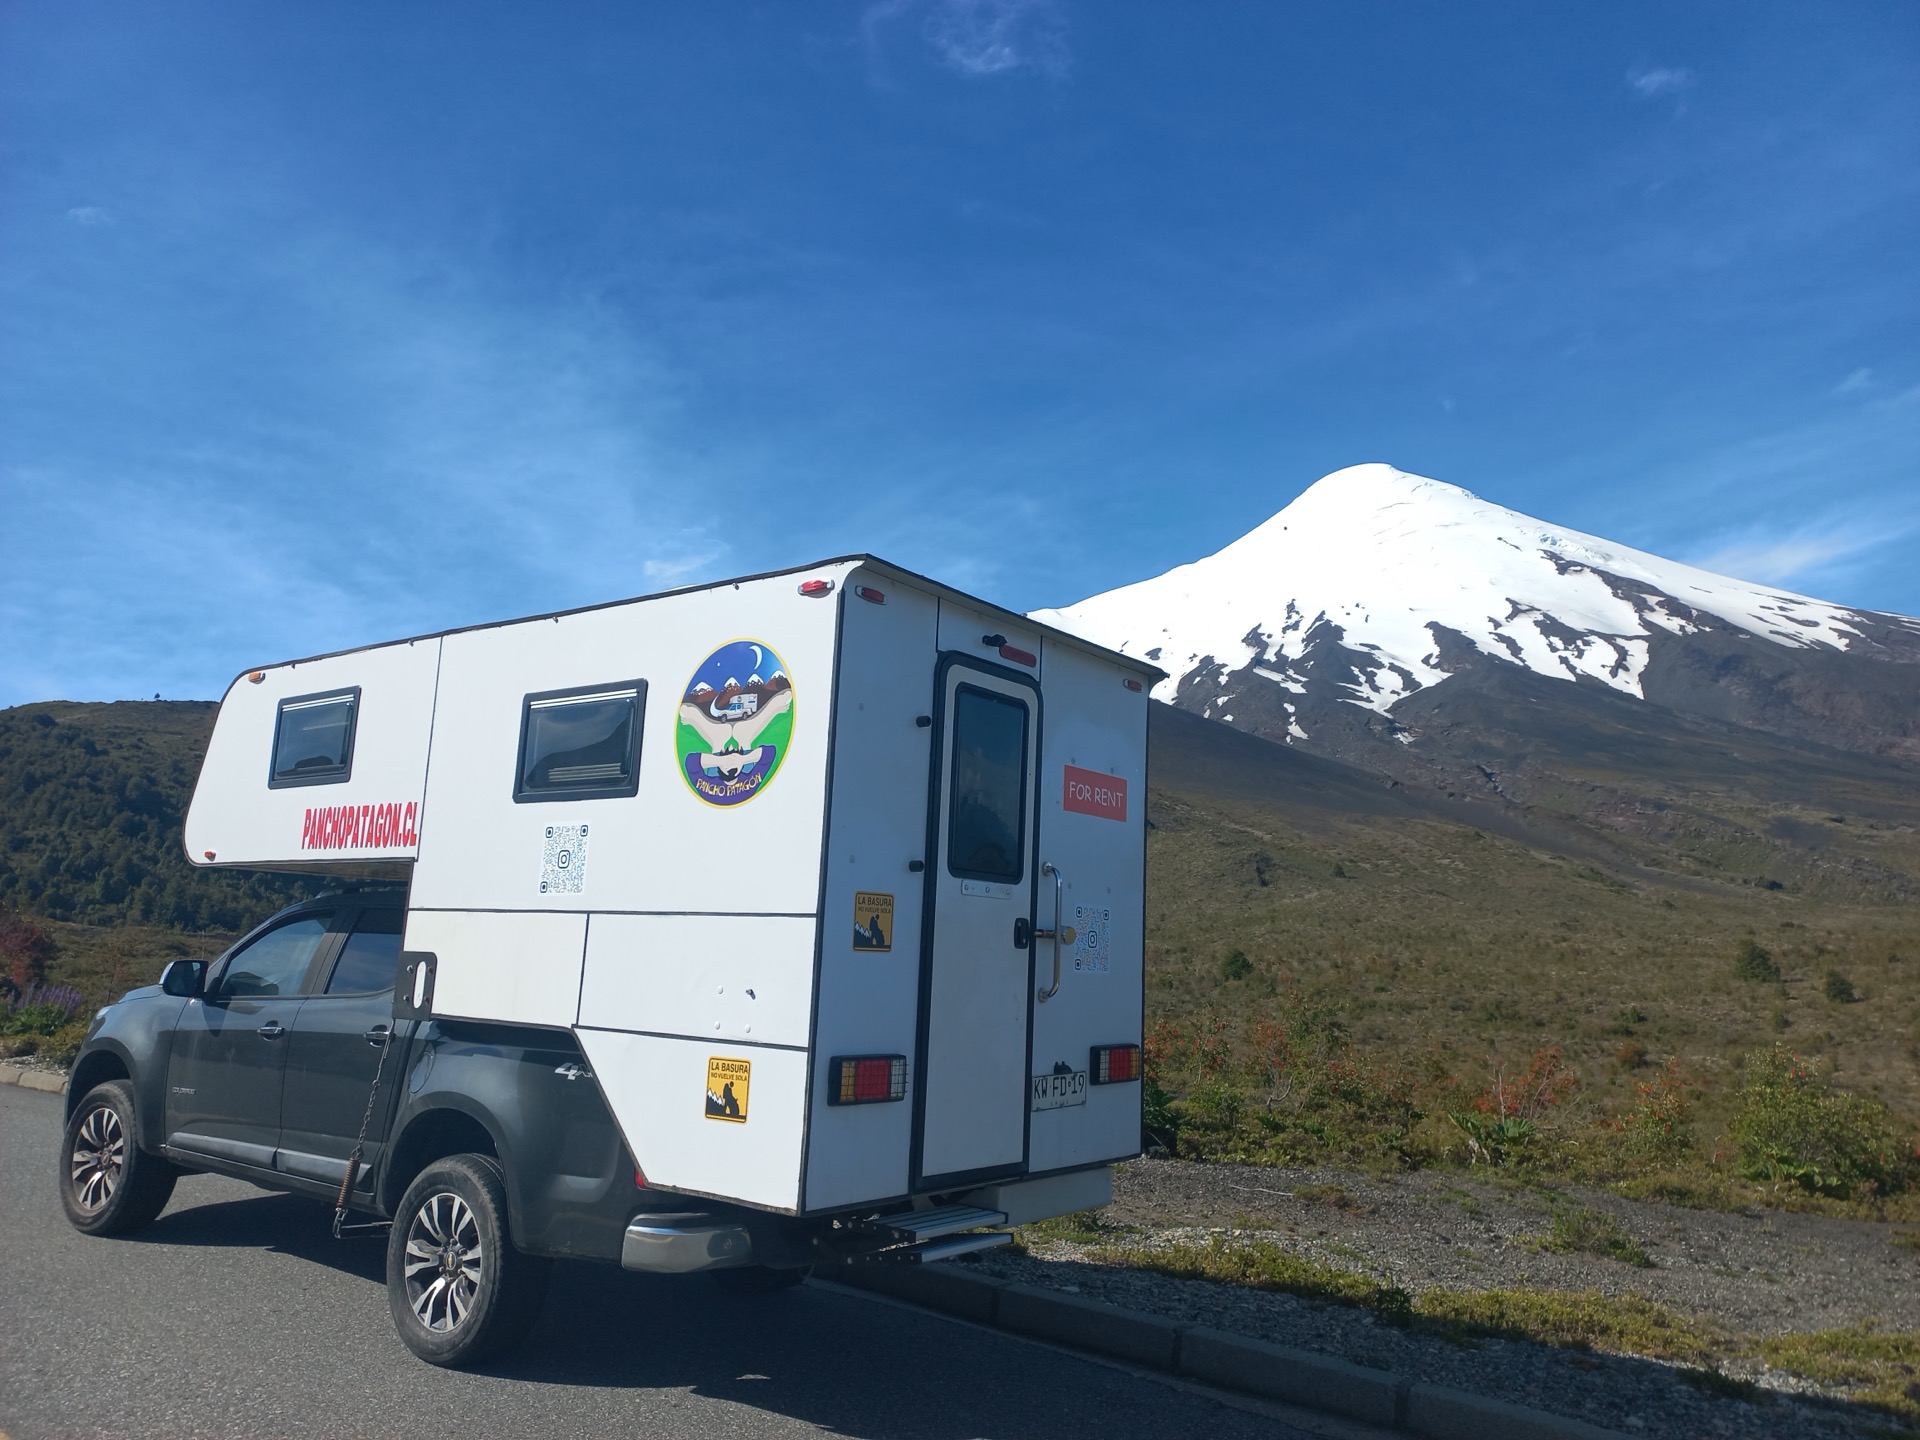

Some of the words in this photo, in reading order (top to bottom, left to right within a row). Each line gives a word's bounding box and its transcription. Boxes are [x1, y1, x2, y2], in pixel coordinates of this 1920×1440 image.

[696, 778, 726, 797] PANCHO
[1069, 781, 1092, 802] FOR
[1094, 787, 1123, 808] RENT
[301, 801, 418, 850] PANCHOPATAGON.CL
[857, 896, 866, 905] LA
[867, 897, 892, 907] BASURA
[711, 1061, 720, 1071] LA
[721, 1062, 748, 1074] BASURA
[735, 1074, 748, 1082] SOLA
